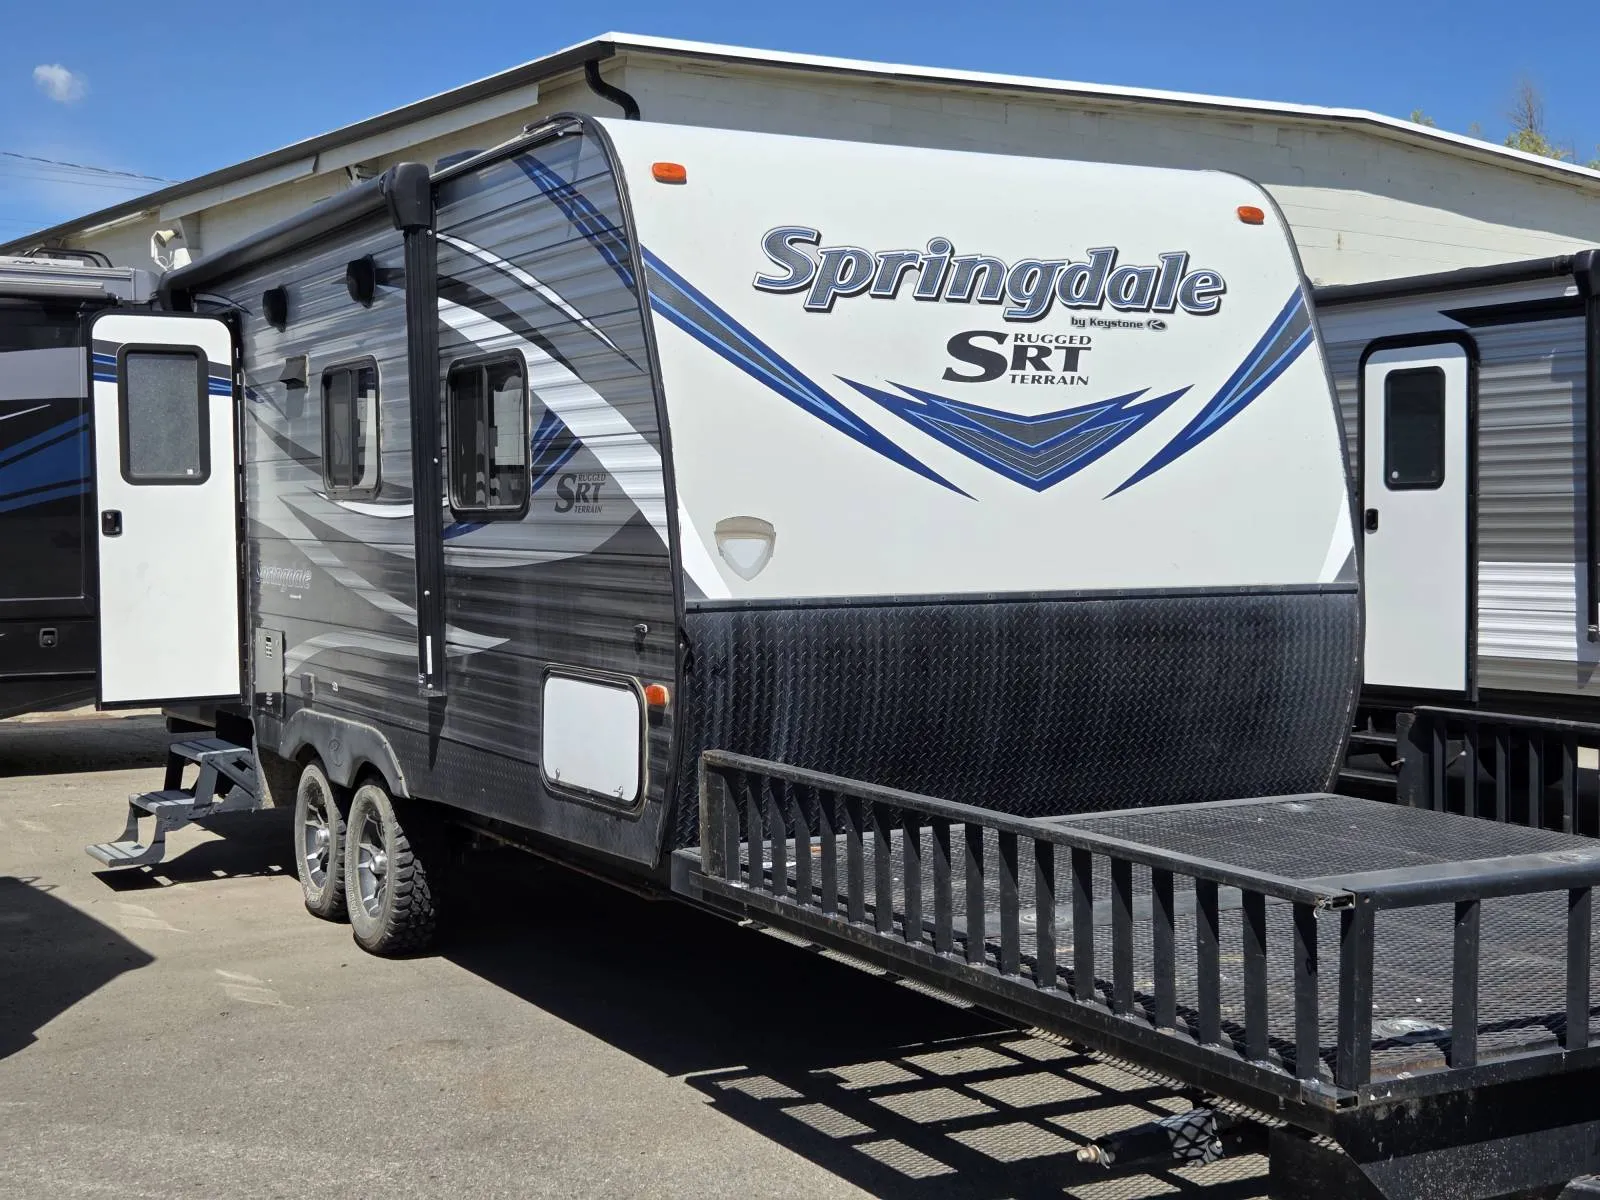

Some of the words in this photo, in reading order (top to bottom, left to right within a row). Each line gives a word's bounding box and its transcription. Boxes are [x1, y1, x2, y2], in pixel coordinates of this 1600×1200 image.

[753, 225, 1227, 322] Springdale
[1071, 317, 1086, 328] by
[1090, 317, 1144, 329] Keystone
[1013, 333, 1092, 345] RUGGED
[942, 330, 1092, 384] SRT
[1010, 374, 1089, 385] TERRAIN
[577, 472, 606, 482] RUGGED
[554, 473, 606, 513] SRT
[574, 505, 603, 514] TERRAIN
